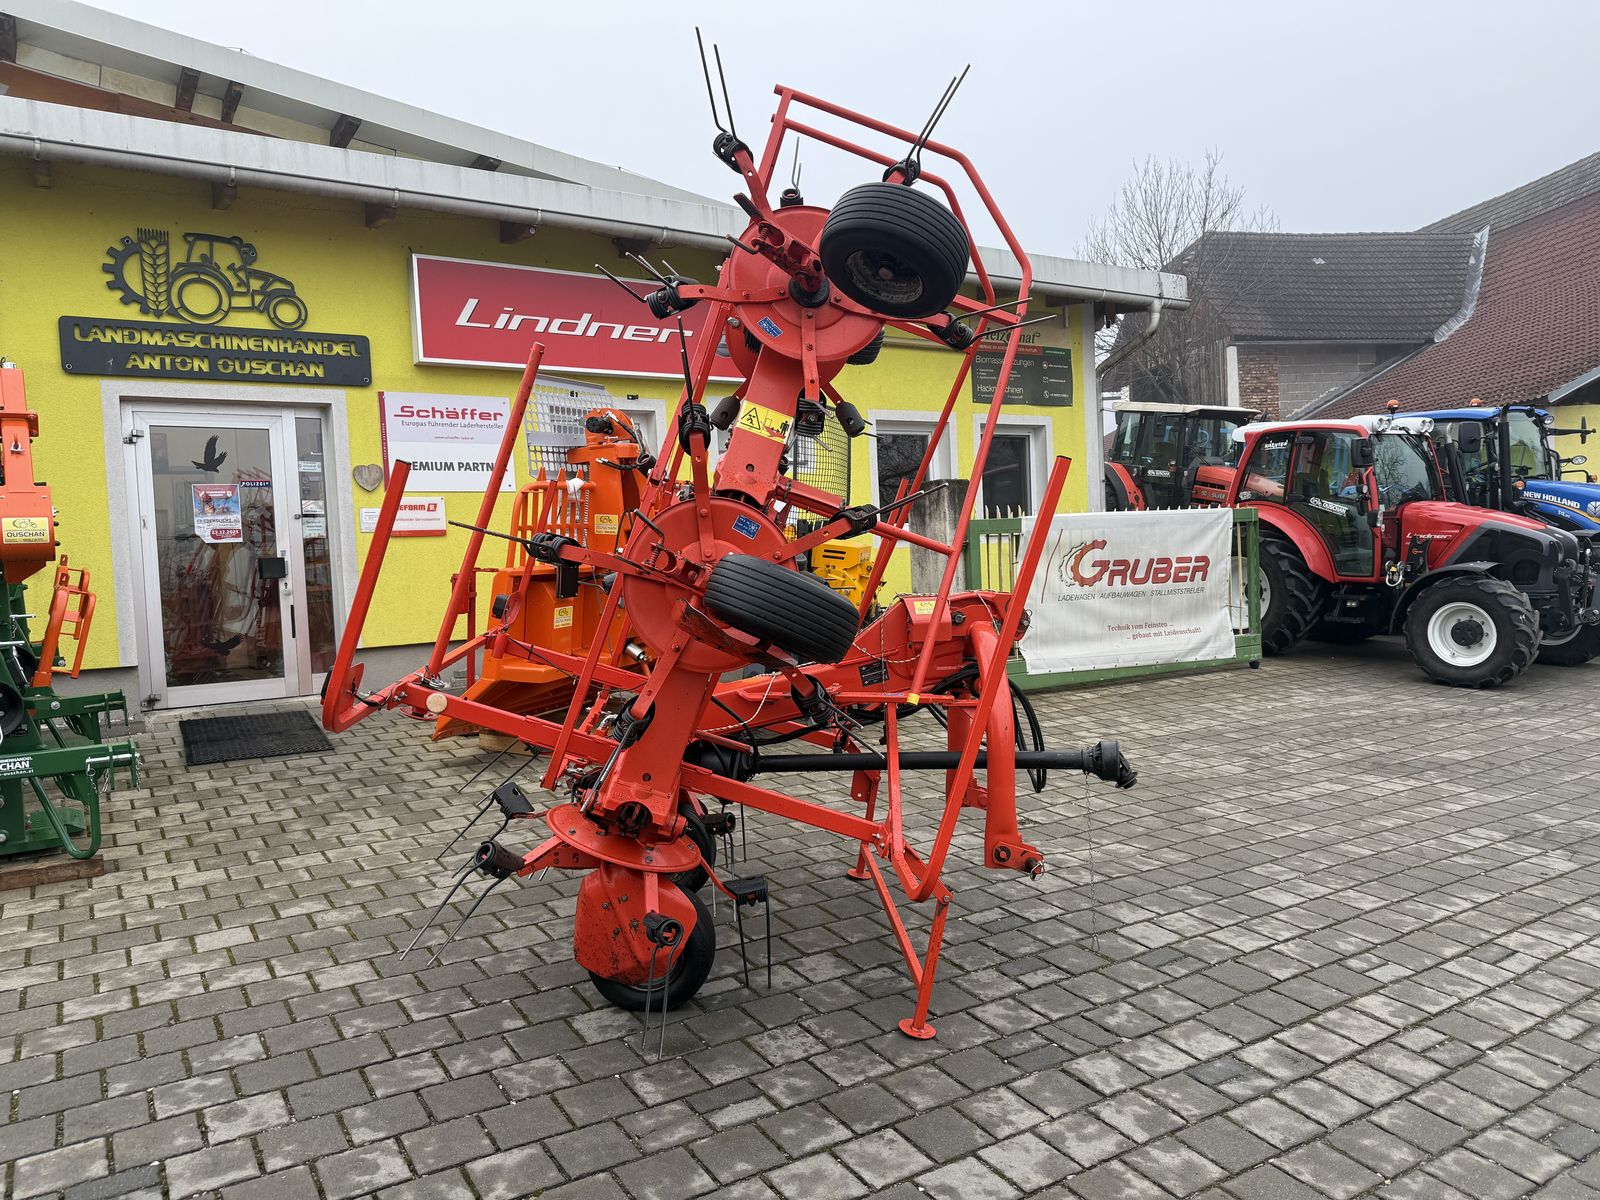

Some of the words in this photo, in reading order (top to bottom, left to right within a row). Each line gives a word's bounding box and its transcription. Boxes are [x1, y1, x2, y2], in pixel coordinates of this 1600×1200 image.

[455, 298, 694, 343] Lindner
[72, 323, 362, 358] LANDMASCHINENHANDEL
[125, 352, 210, 373] ANTON
[216, 358, 325, 378] OUSCHAN
[975, 355, 1035, 368] Biomasszungen
[977, 384, 1024, 394] Hackmchinen
[394, 405, 504, 421] Schäffer
[401, 420, 427, 428] Europas
[459, 421, 504, 430] Laderhersteller
[408, 461, 455, 472] EMIUM
[1523, 490, 1542, 499] NEW
[1542, 493, 1581, 509] HOLLAND
[1071, 539, 1211, 587] GRUBER
[1058, 593, 1096, 602] LADEWAGEN
[1099, 590, 1146, 599] AUFBAUWAGEN
[1150, 586, 1205, 597] STALLMISTSTREUER
[1107, 624, 1130, 632] Technik
[1144, 620, 1168, 630] Feinsten
[1131, 631, 1151, 640] gebaut
[1164, 626, 1202, 637] Leidenschaft!
